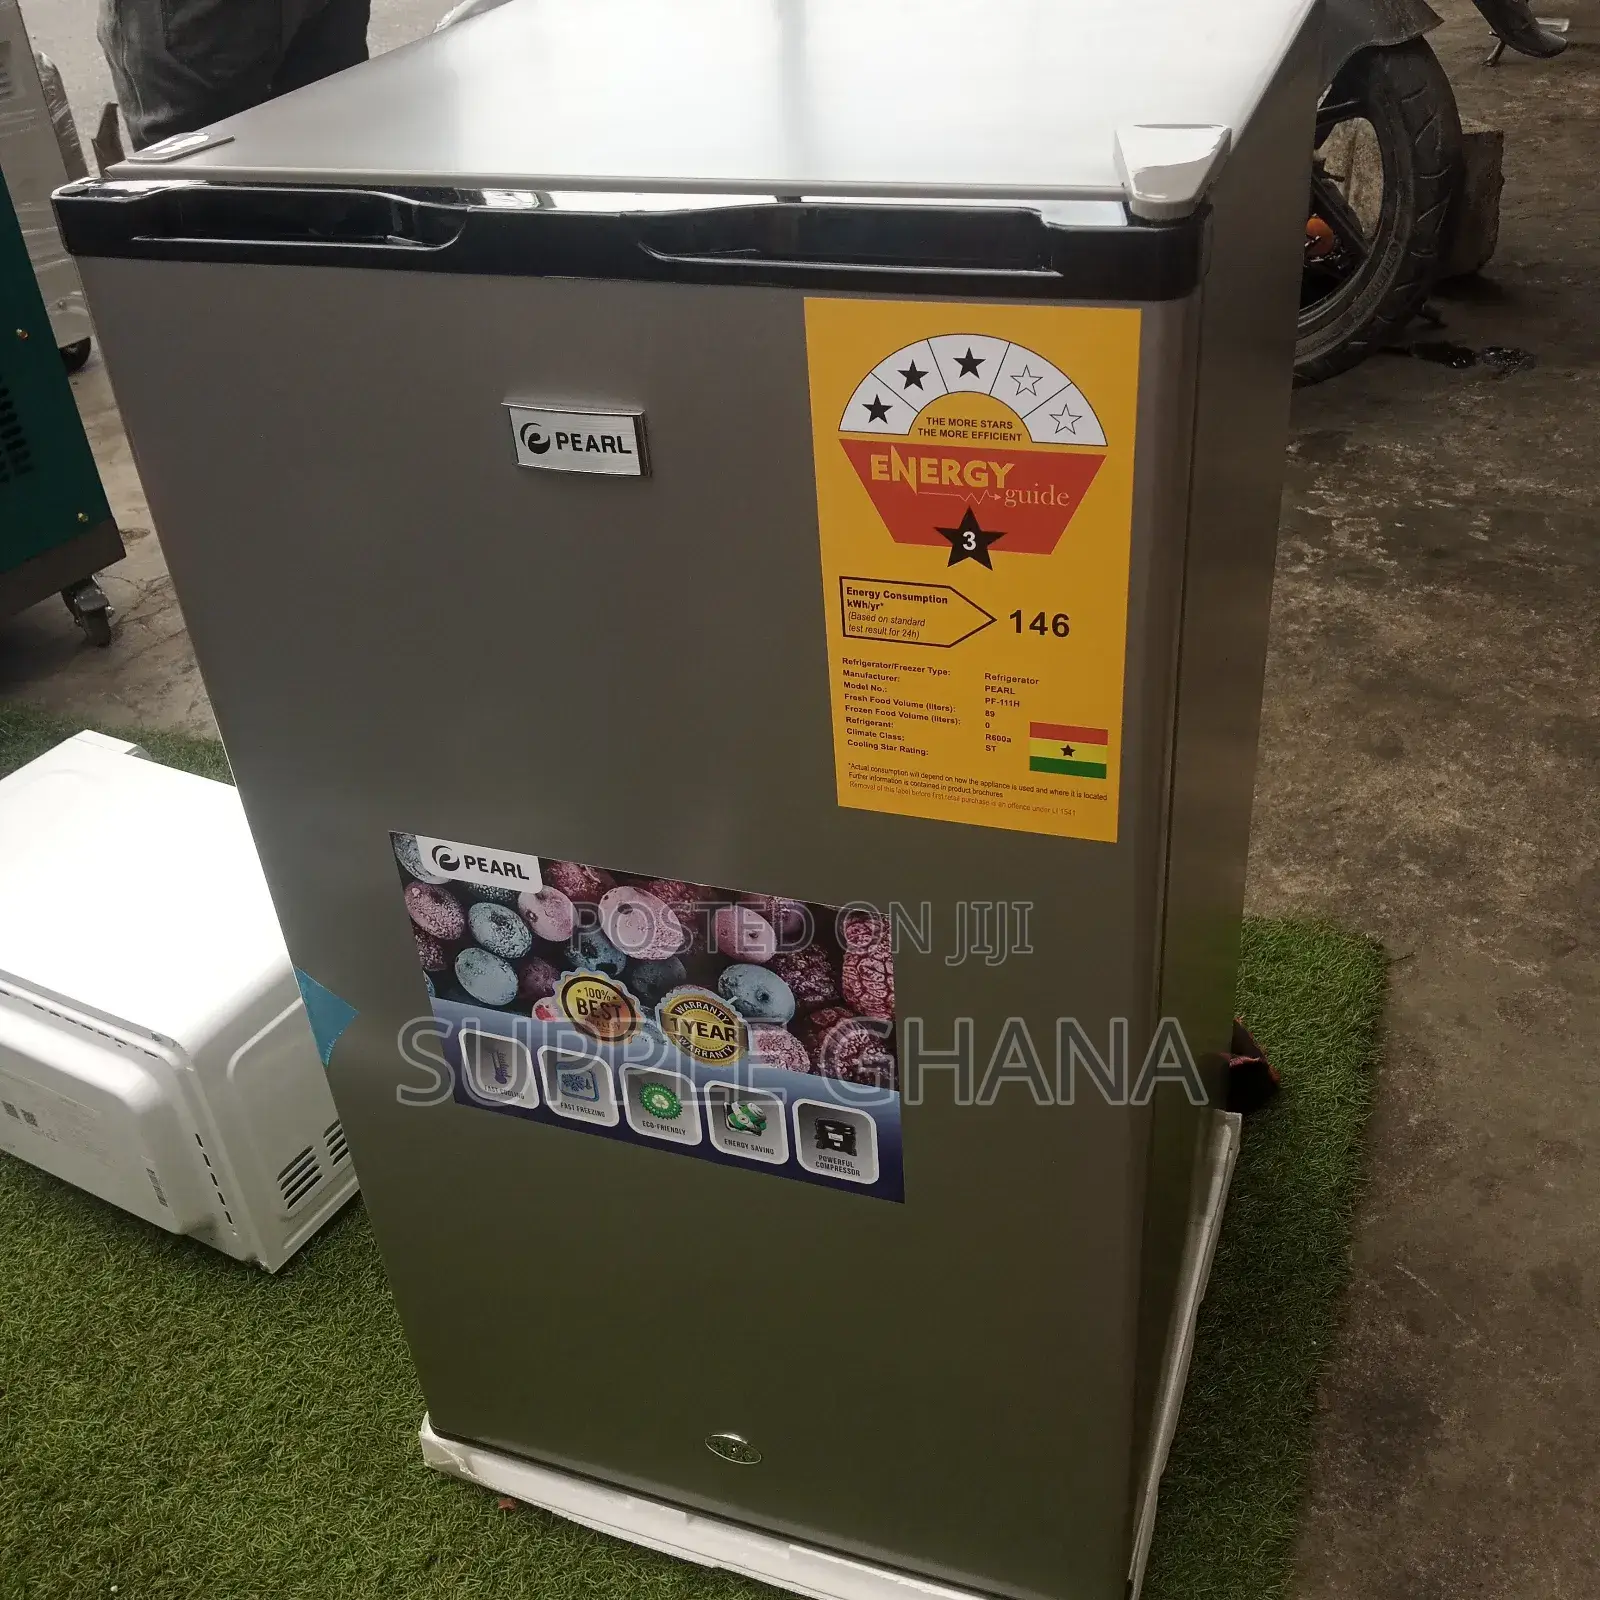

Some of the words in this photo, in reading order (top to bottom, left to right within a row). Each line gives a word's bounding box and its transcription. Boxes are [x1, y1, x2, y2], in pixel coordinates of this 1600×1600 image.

[926, 417, 945, 426] THE
[948, 418, 977, 428] MORE
[980, 420, 1013, 429] STARS
[555, 432, 632, 454] PEARL
[918, 428, 937, 437] THE
[939, 429, 969, 439] MORE
[971, 431, 1022, 442] EFFICIENT
[870, 445, 1015, 496] ENERGY
[1004, 482, 1070, 508] guide
[962, 531, 977, 550] 3
[846, 587, 880, 599] Energy
[883, 591, 948, 604] Consumption
[848, 611, 876, 622] (Based
[890, 616, 926, 627] standard
[1009, 609, 1070, 637] 146
[865, 626, 887, 635] result
[889, 628, 899, 636] for
[901, 630, 920, 640] 24h)
[842, 657, 925, 673] Refrigerator/Freezer
[927, 667, 951, 676] Type:
[842, 669, 900, 682] Manufacturer:
[984, 672, 1039, 684] Refrigerator
[844, 681, 869, 690] Model
[985, 685, 1015, 694] PEARL
[844, 693, 868, 702] Fresh
[870, 696, 891, 705] Food
[893, 699, 924, 709] Volume
[926, 703, 956, 713] (liters):
[985, 698, 1020, 708] PF-111H
[845, 704, 873, 714] Frozen
[875, 708, 896, 717] Food
[898, 711, 929, 721] Volume
[931, 715, 961, 725] (liters):
[845, 716, 893, 728] Refrigerant:
[846, 728, 877, 738] Climate
[879, 731, 904, 741] Class:
[985, 734, 1011, 743] R600a
[847, 739, 879, 750] Cooling
[881, 743, 897, 751] Star
[899, 745, 929, 756] Rating:
[848, 772, 868, 780] Further
[870, 775, 902, 785] information
[910, 780, 939, 790] contained
[948, 785, 971, 796] product
[972, 787, 1003, 798] brochures
[870, 765, 909, 777] consumption
[920, 772, 943, 781] depend
[954, 776, 967, 784] how
[980, 779, 1010, 790] appliance
[1018, 785, 1034, 793] used
[1049, 789, 1069, 797] where
[1083, 792, 1107, 801] located
[850, 781, 875, 791] Removal
[883, 785, 895, 793] this
[1007, 802, 1030, 811] offence
[463, 855, 530, 880] PEARL
[584, 987, 611, 1001] 100%
[576, 997, 622, 1021] BEST
[675, 1001, 730, 1023] WARRANTY
[679, 1036, 733, 1059] WARRANTY
[560, 1102, 575, 1111] FAST
[576, 1105, 606, 1118] FREEZING
[642, 1120, 686, 1136] ECO-FRIENDLY
[724, 1138, 749, 1150] ENERGY
[750, 1143, 774, 1155] SAVING
[815, 1161, 861, 1177] COMPRESSOR
[818, 1154, 855, 1169] POWERFUL
